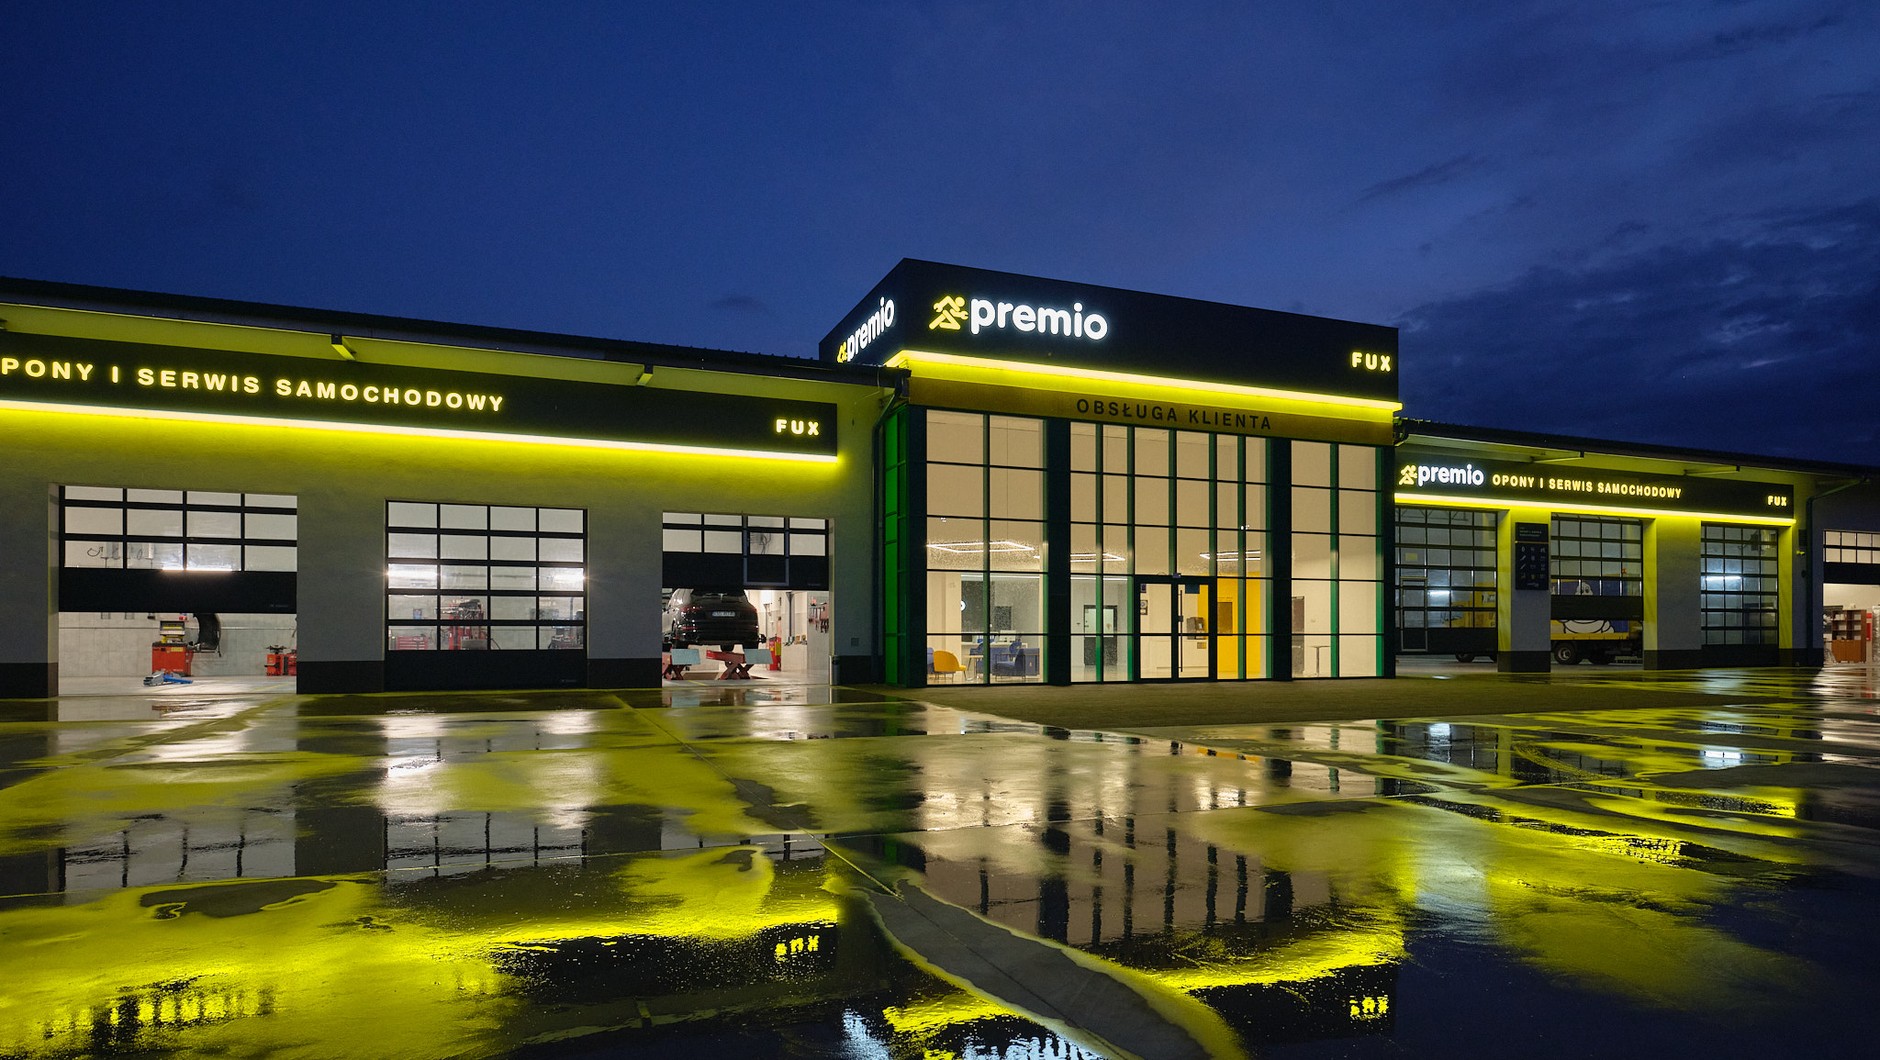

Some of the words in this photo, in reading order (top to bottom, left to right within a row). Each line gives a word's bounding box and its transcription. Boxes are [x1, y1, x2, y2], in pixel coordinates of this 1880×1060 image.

[847, 296, 895, 362] premio
[970, 298, 1108, 341] premio
[1351, 351, 1391, 372] FUX
[1, 357, 94, 381] PONY
[111, 365, 119, 384] I
[137, 368, 260, 394] SERWIS
[276, 378, 503, 412] SAMOCHODOWY
[775, 418, 820, 436] FUX
[1076, 398, 1178, 422] OBSŁUGA
[1189, 409, 1271, 430] KLIENTA
[1417, 463, 1485, 487] premio
[1491, 473, 1535, 488] OPONY
[1539, 477, 1544, 489] I
[1548, 477, 1594, 493] SERWIS
[1597, 481, 1682, 499] SAMOCHODOWY
[1767, 495, 1787, 507] FUX
